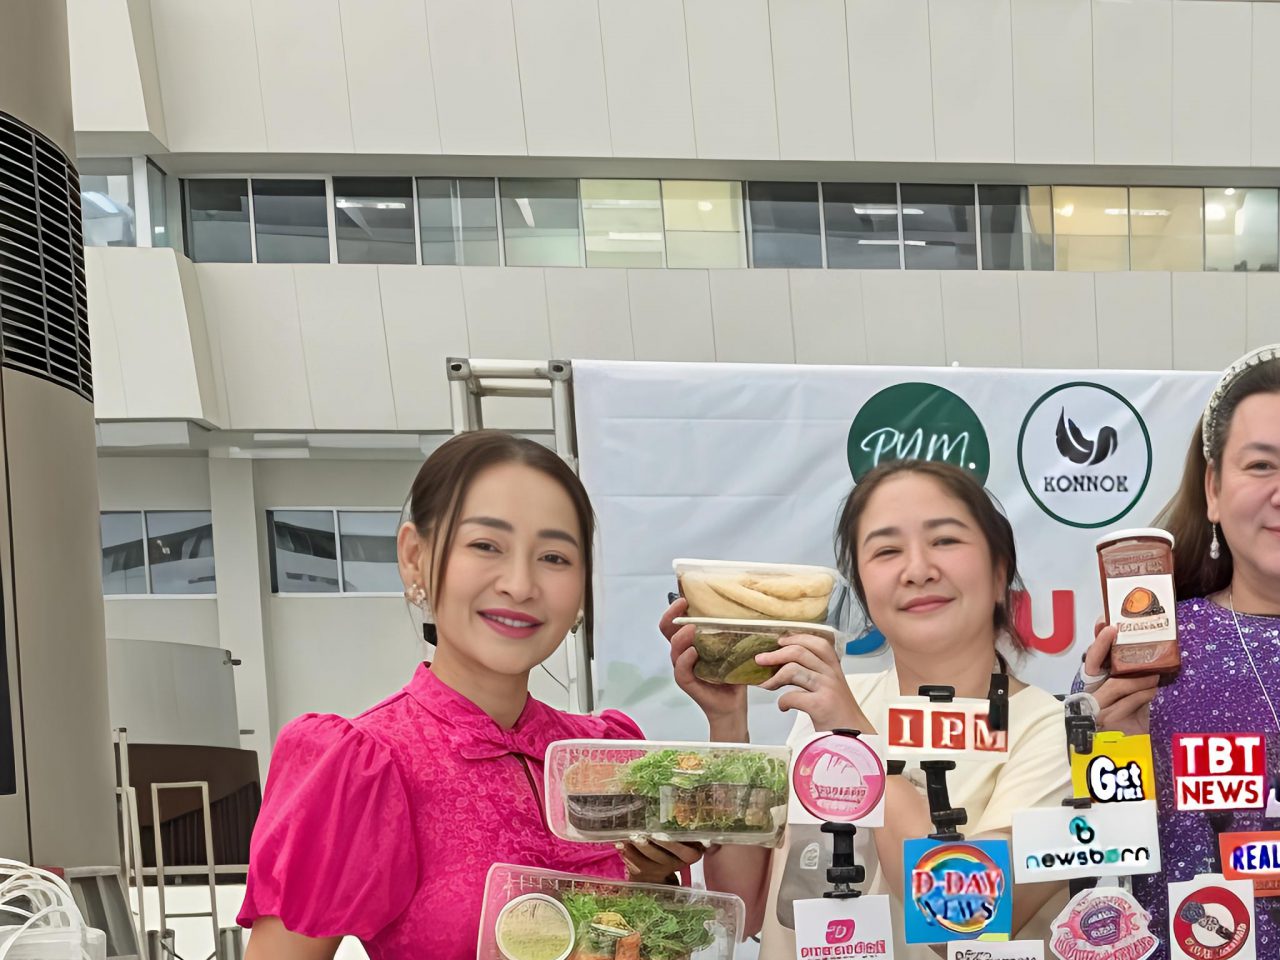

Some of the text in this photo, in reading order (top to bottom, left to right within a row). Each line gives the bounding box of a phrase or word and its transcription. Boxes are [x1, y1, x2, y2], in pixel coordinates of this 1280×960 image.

[1043, 474, 1129, 493] KONNOK
[1179, 736, 1260, 775] TBT
[1088, 755, 1142, 802] Get
[1181, 778, 1259, 805] NEWS
[911, 868, 1002, 900] D-DAY
